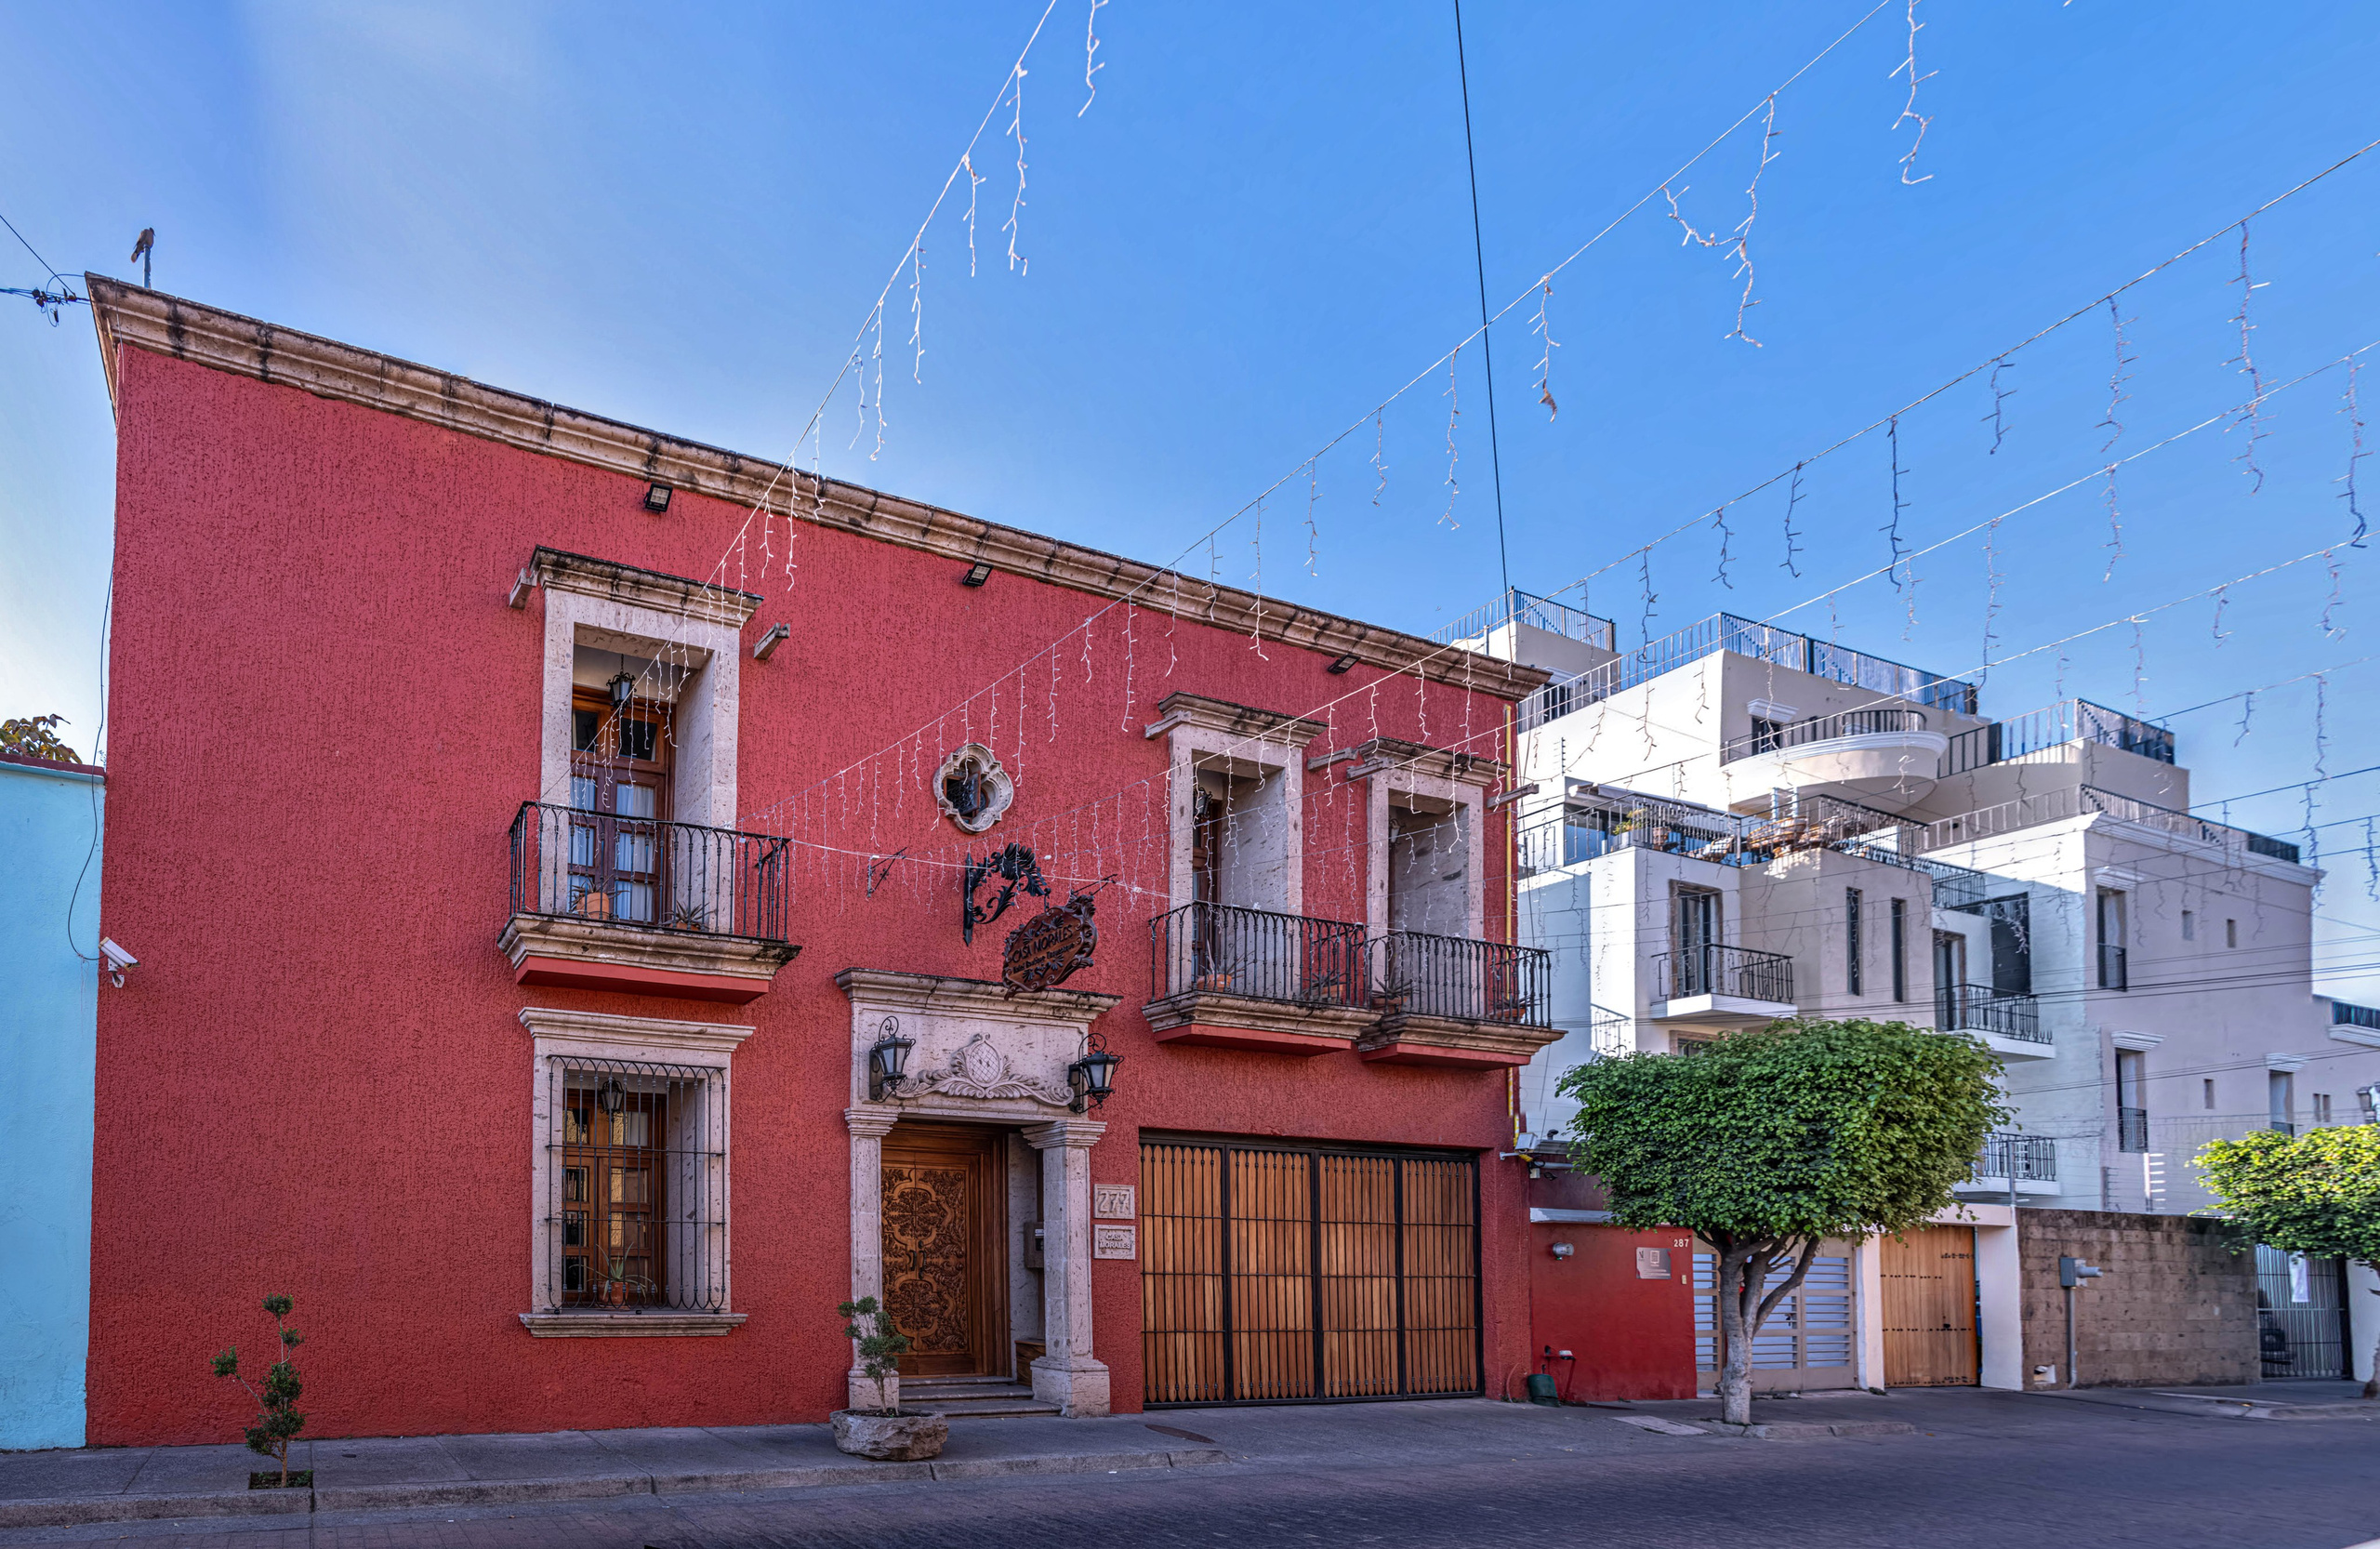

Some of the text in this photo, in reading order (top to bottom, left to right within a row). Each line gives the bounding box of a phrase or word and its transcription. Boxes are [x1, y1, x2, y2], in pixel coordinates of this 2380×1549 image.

[1012, 944, 1032, 962] CASA
[1034, 924, 1073, 953] MORALES
[1098, 1191, 1128, 1214] 277
[1106, 1232, 1123, 1241] CASA
[1099, 1240, 1130, 1250] MORALES
[1673, 1238, 1689, 1248] 287
